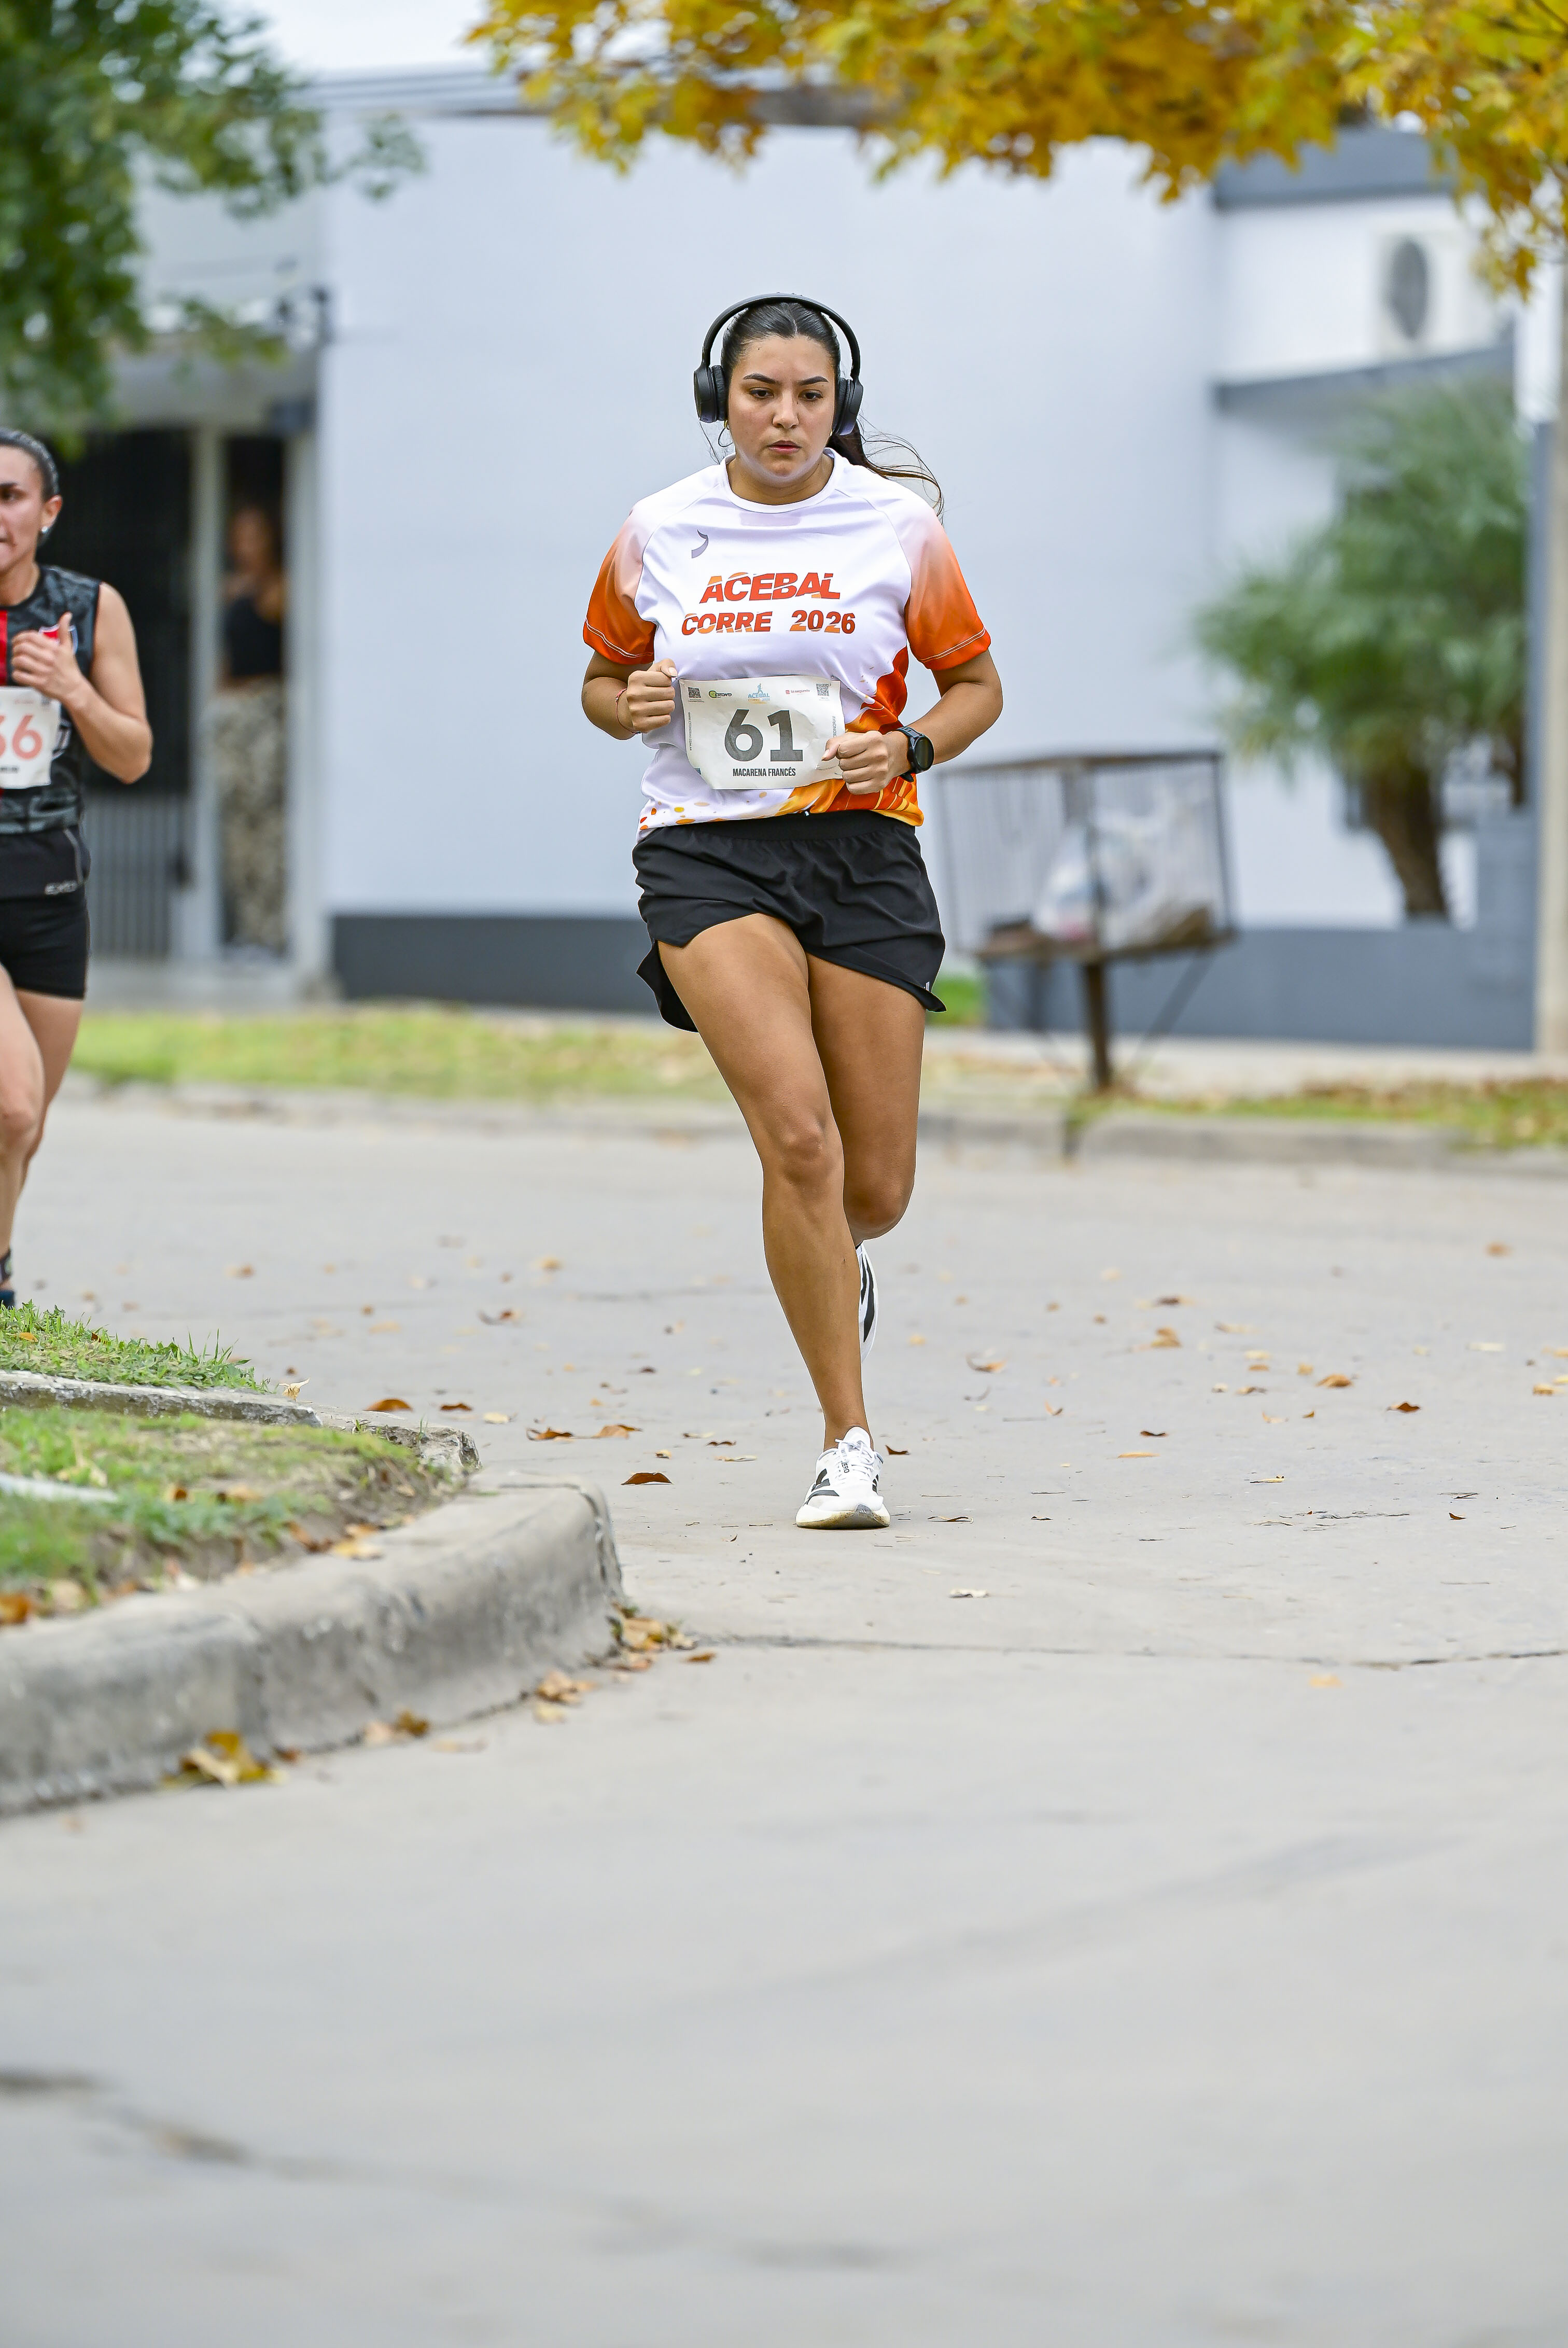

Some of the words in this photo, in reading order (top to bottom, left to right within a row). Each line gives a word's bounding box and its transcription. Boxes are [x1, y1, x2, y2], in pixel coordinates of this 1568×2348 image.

[699, 572, 840, 604] ACEBAL
[681, 611, 773, 635] CORRE
[789, 610, 856, 634] 2026
[0, 714, 43, 760] 6
[724, 709, 803, 762] 61
[733, 768, 767, 777] MACARENA
[768, 766, 796, 777] FRANCÉS
